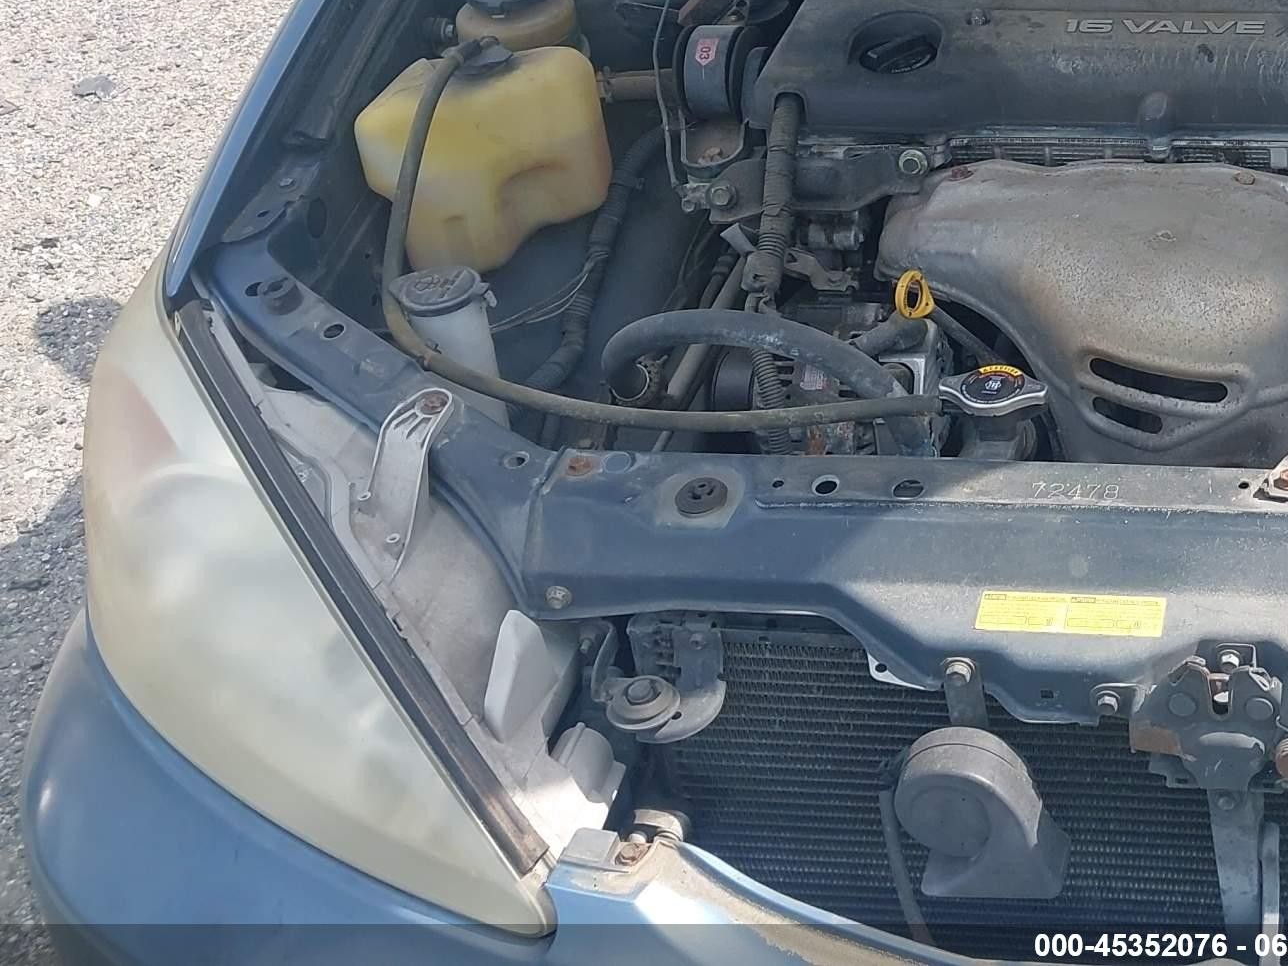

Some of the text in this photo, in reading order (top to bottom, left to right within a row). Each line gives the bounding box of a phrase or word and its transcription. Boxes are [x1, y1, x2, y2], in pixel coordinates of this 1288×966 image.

[1066, 18, 1266, 35] 16 VALVE
[700, 46, 711, 60] 03
[1032, 480, 1120, 500] 72478
